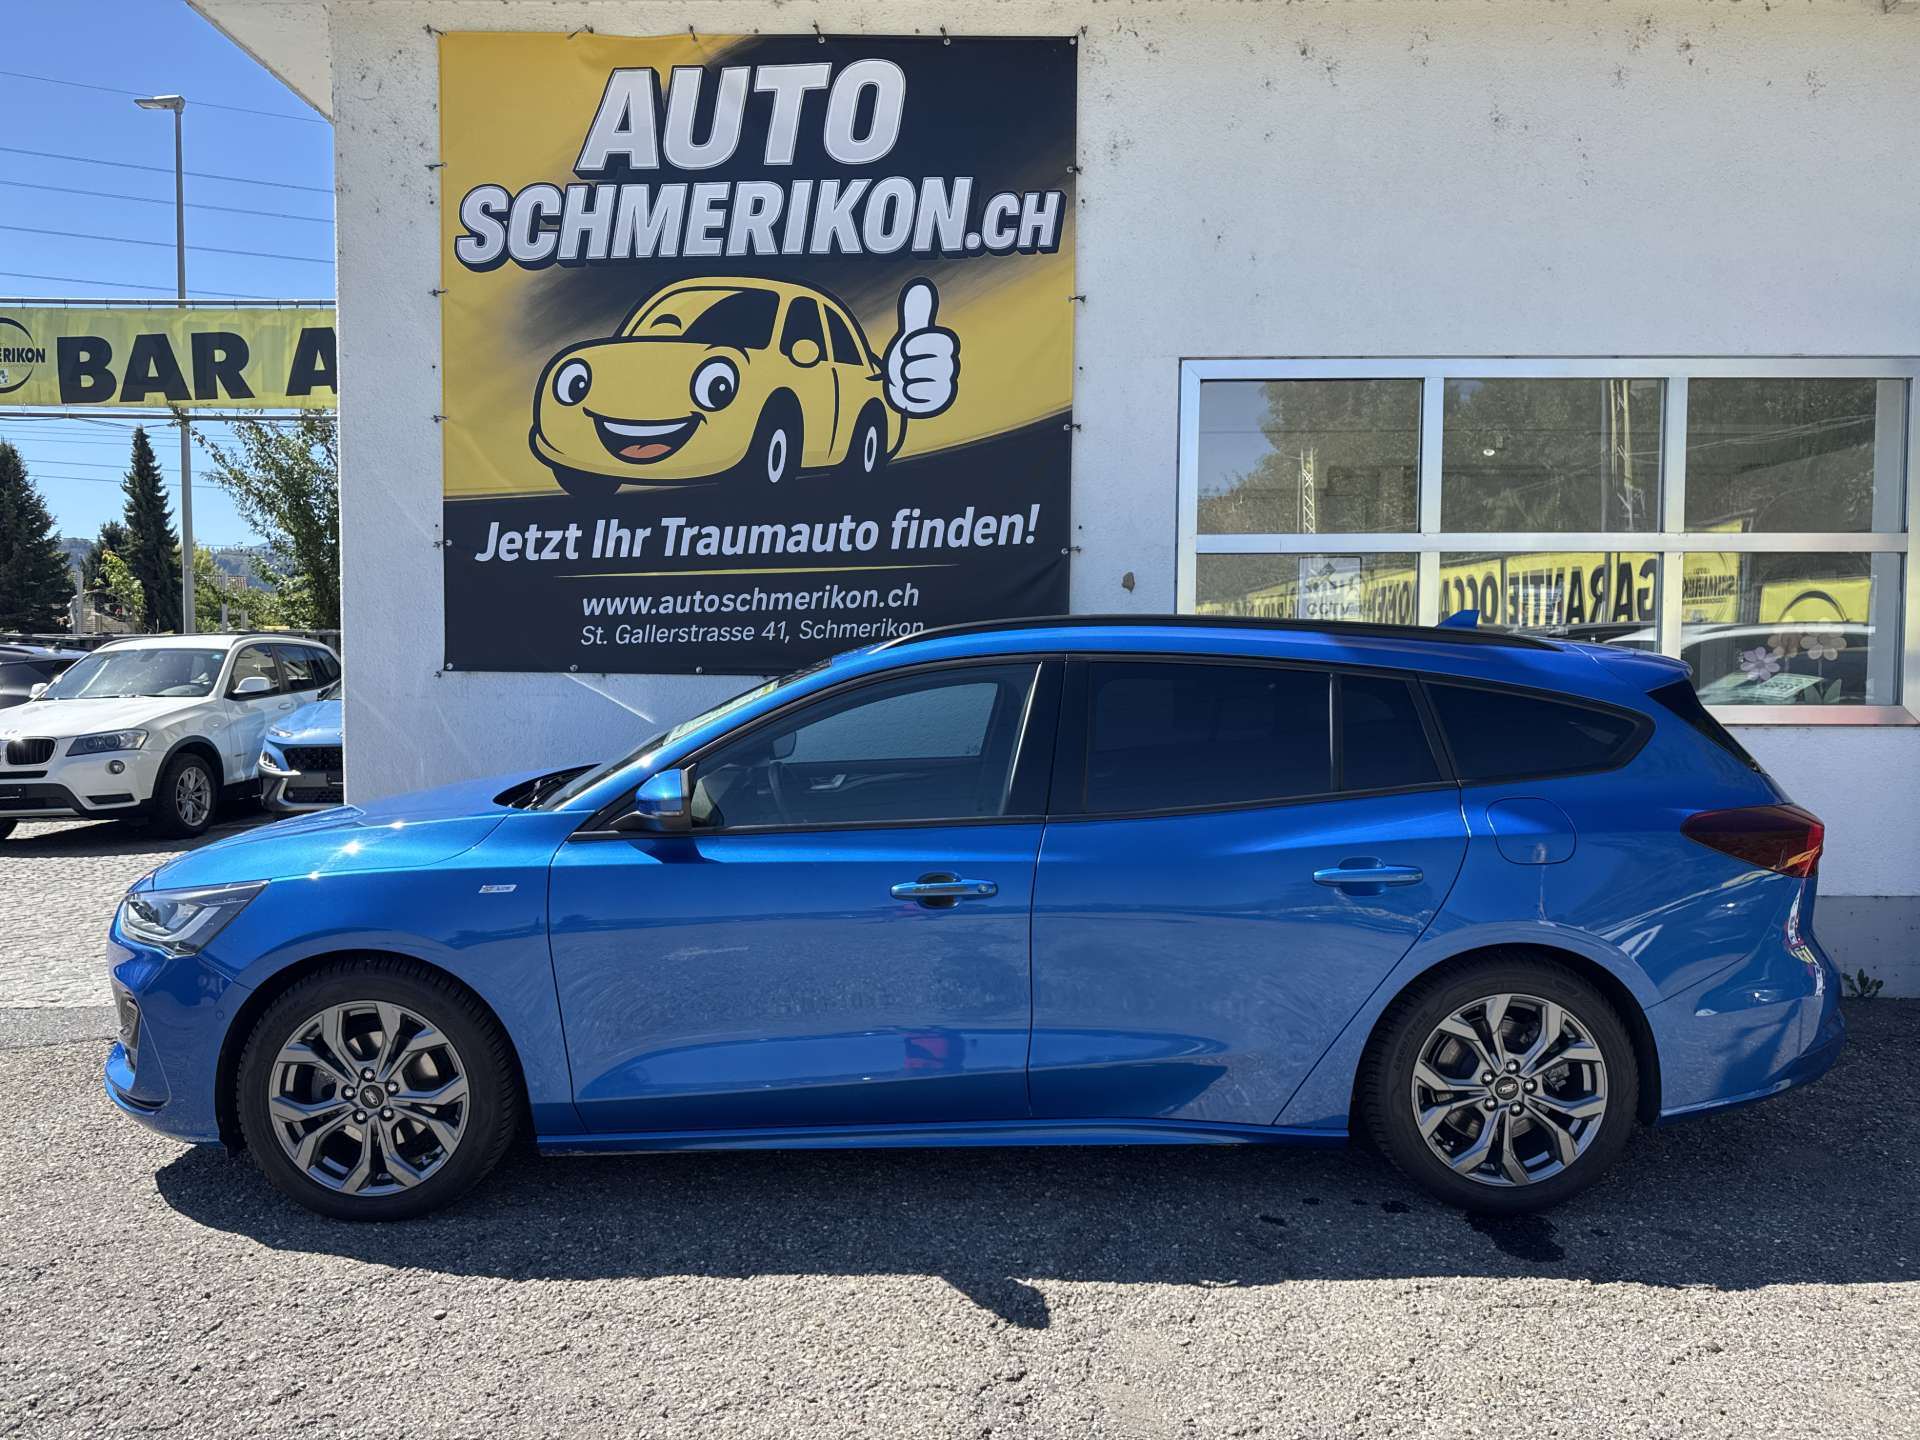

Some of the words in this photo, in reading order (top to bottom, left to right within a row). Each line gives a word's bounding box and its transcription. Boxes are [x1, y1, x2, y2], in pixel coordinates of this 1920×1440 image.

[575, 58, 907, 172] AUTO
[455, 175, 1062, 267] SCHMERIKON.CH
[56, 331, 256, 404] BAR
[474, 521, 583, 562] Jetzt
[591, 518, 652, 559] Ihr
[660, 514, 879, 557] Traumauto
[890, 503, 1041, 550] finden!
[580, 625, 608, 646] St.
[615, 624, 755, 645] Gallerstrasse
[761, 621, 790, 644] 41,
[799, 618, 925, 640] Schmerikon
[582, 583, 919, 616] www.autoschmerikon.ch
